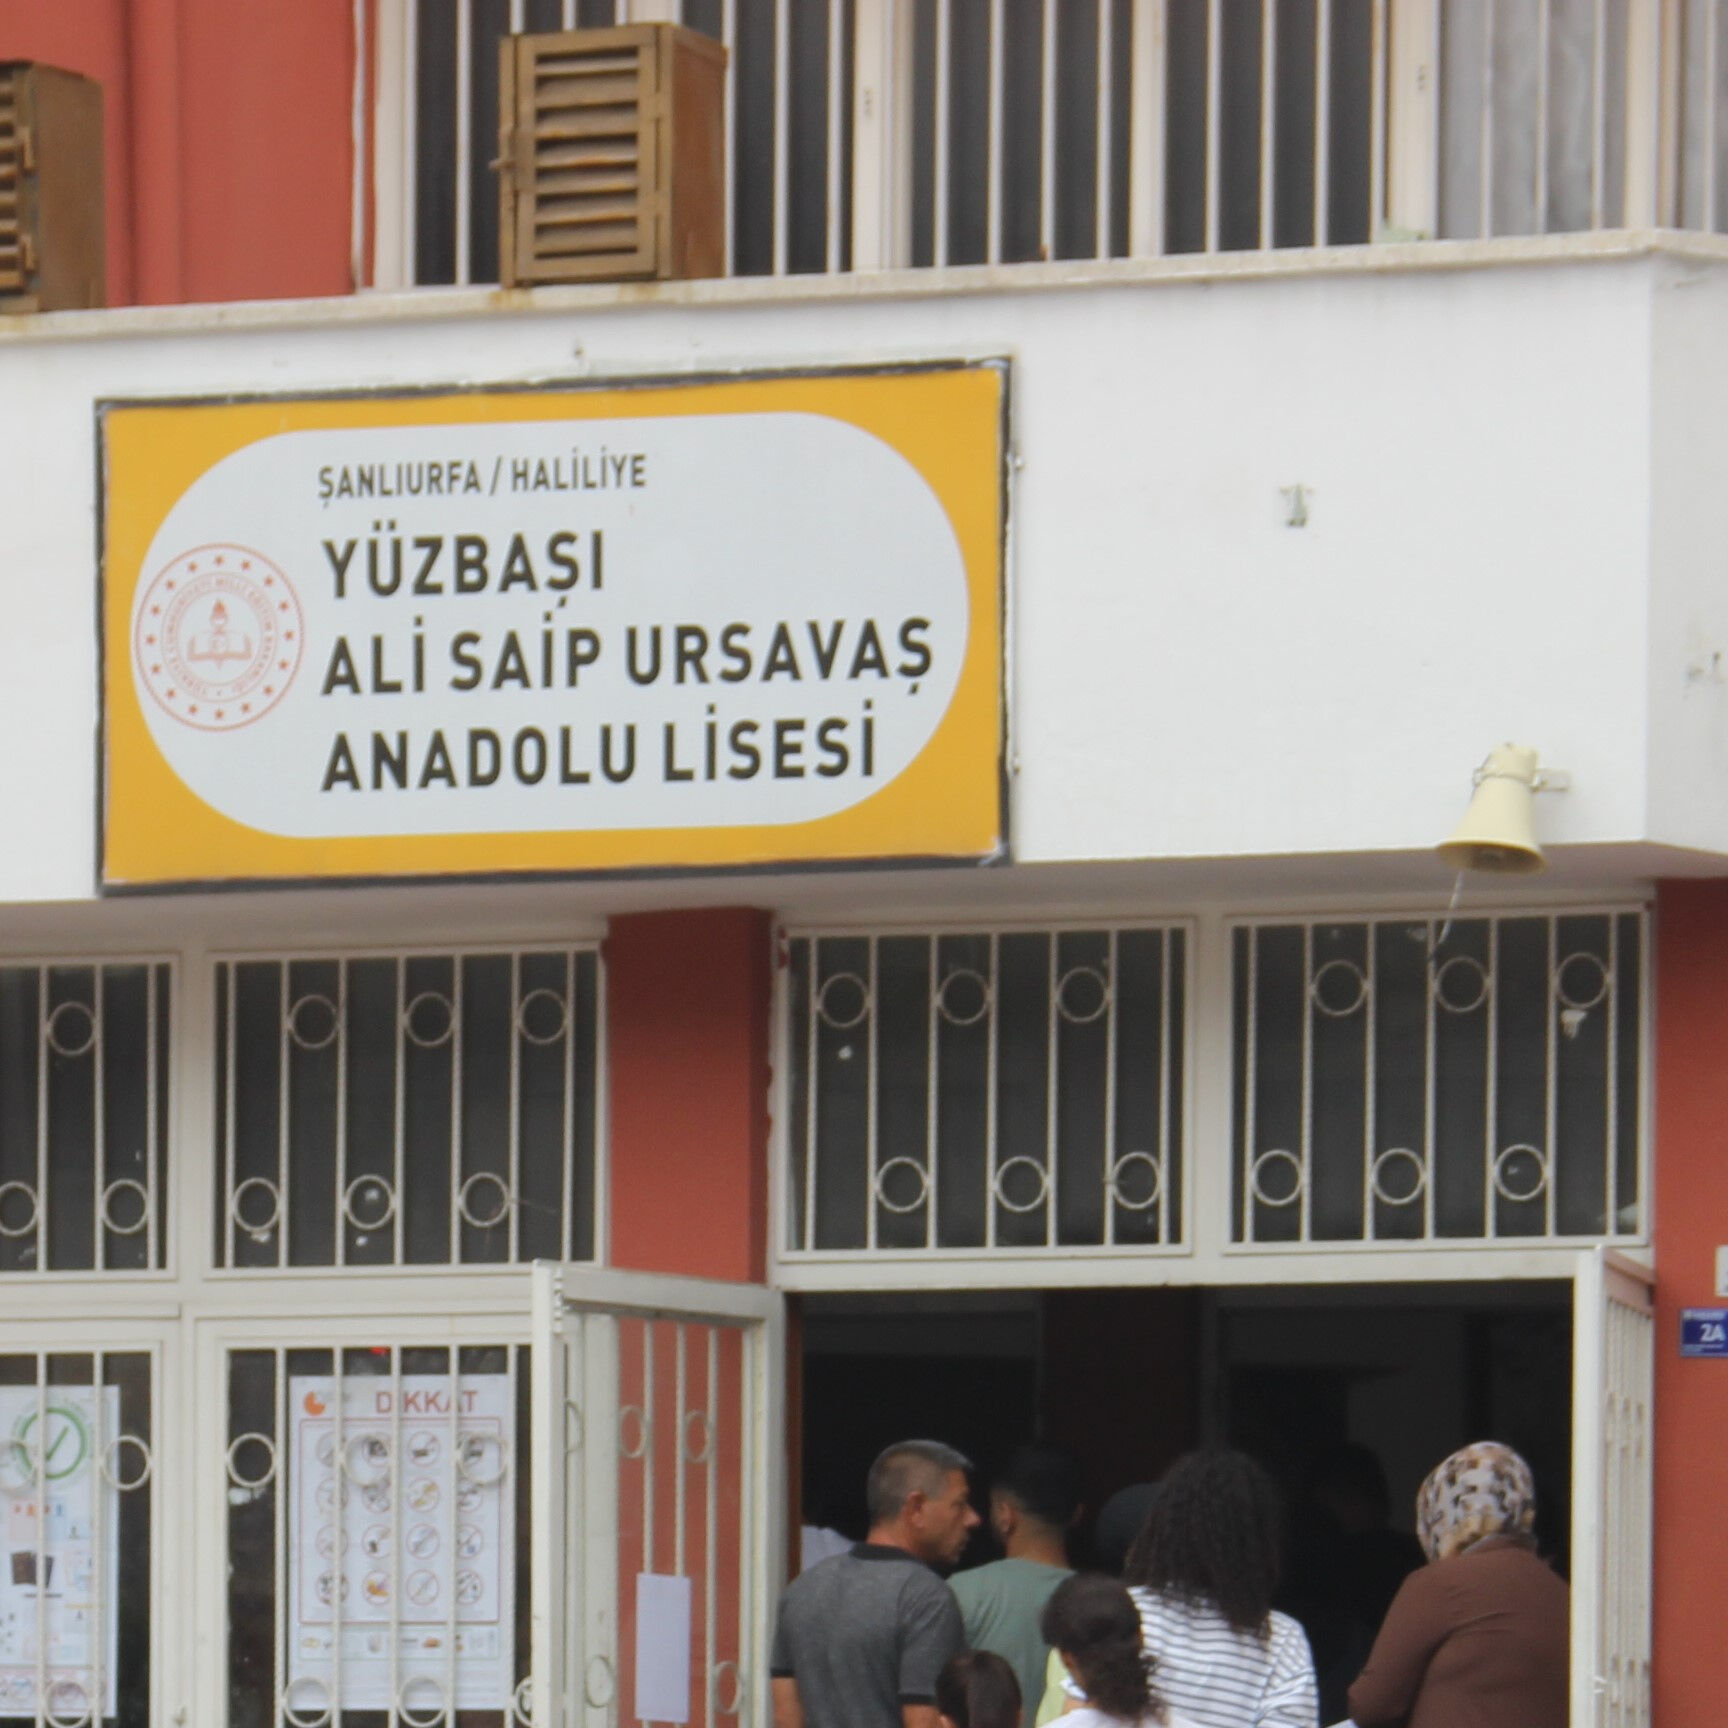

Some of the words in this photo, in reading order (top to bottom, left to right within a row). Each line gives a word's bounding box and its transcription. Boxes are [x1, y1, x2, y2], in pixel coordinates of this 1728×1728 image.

[318, 461, 481, 508] ŞANLIURFA
[489, 456, 504, 496] /
[511, 445, 647, 491] HALİLİYE
[322, 519, 603, 608] YÜZBAŞI
[322, 616, 426, 696] ALİ
[450, 611, 601, 692] SAİP
[625, 617, 933, 695] URSAVAŞ
[322, 724, 637, 792] ANADOLU
[663, 698, 874, 783] LİSESİ
[1700, 1323, 1726, 1342] 2A
[376, 1390, 478, 1414] DKKAT
